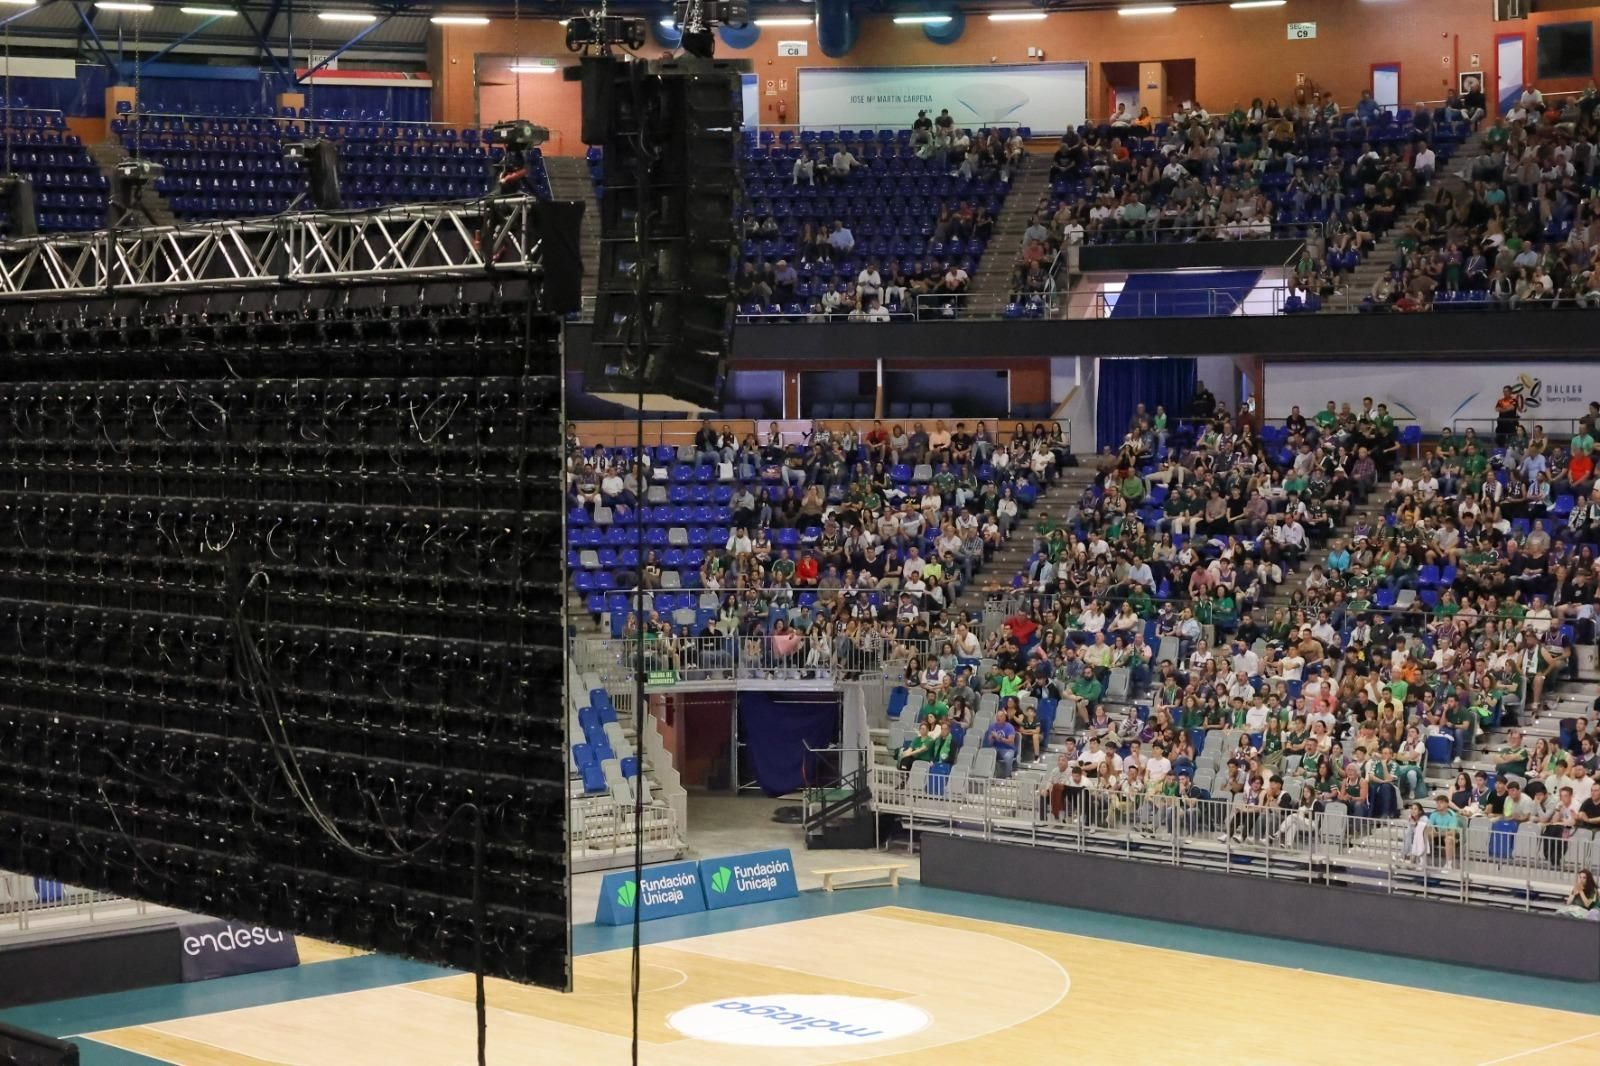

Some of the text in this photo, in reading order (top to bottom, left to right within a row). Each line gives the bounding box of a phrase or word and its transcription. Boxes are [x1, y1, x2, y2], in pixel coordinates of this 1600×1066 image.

[1297, 30, 1308, 38] C9
[787, 48, 799, 56] C8
[904, 95, 933, 103] CARPENA
[734, 860, 789, 879] Fundación
[640, 873, 696, 892] Fundación
[737, 875, 777, 892] Unicaja
[642, 889, 684, 906] Unicaja
[712, 1001, 883, 1037] málaga
